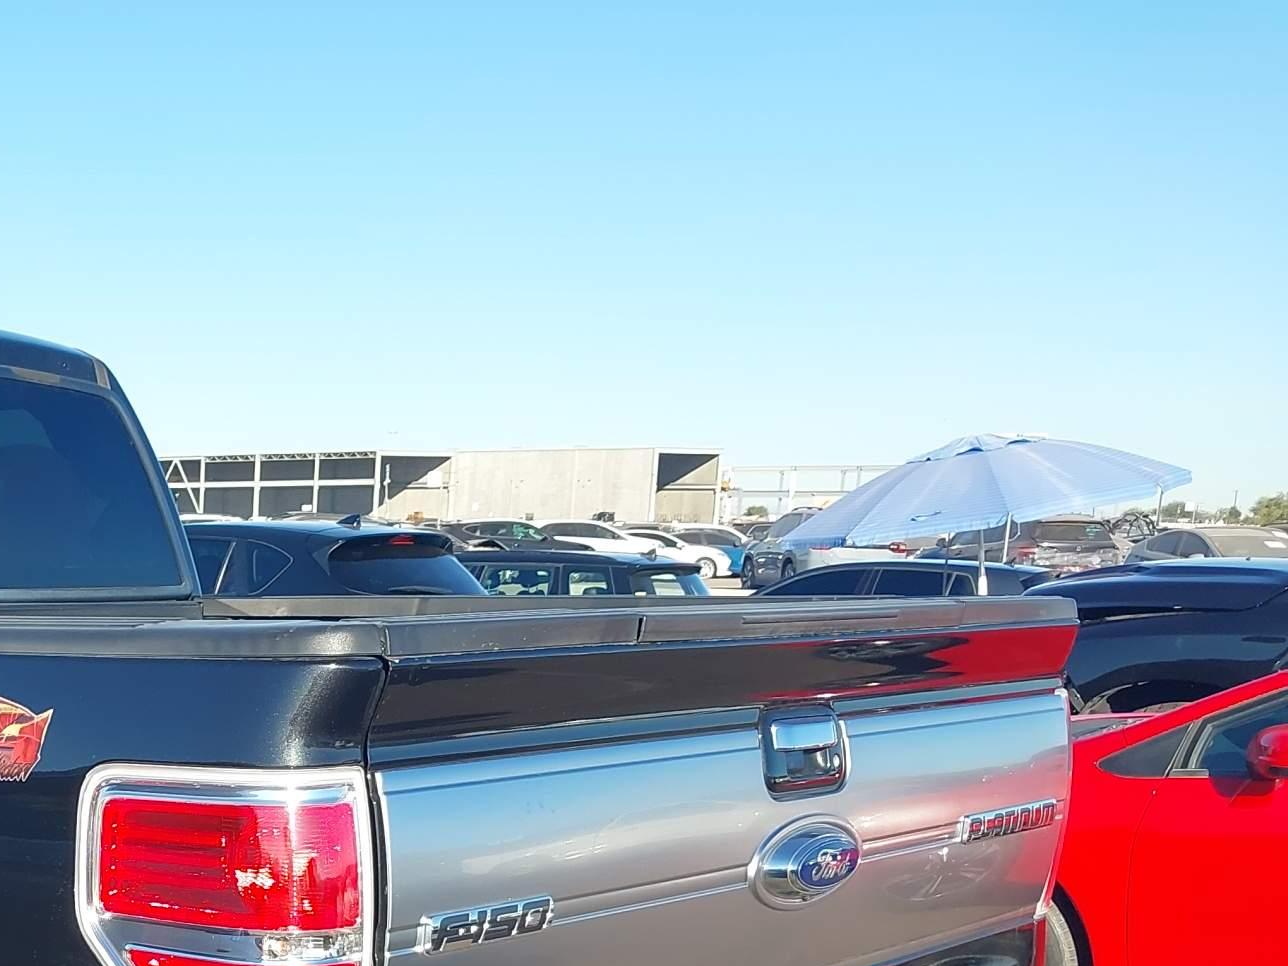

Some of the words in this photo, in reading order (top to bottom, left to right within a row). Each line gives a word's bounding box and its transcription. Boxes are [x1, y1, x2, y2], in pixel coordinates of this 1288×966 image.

[964, 800, 1056, 842] PLATINUM
[811, 847, 852, 881] Ford
[424, 896, 554, 954] F-150
